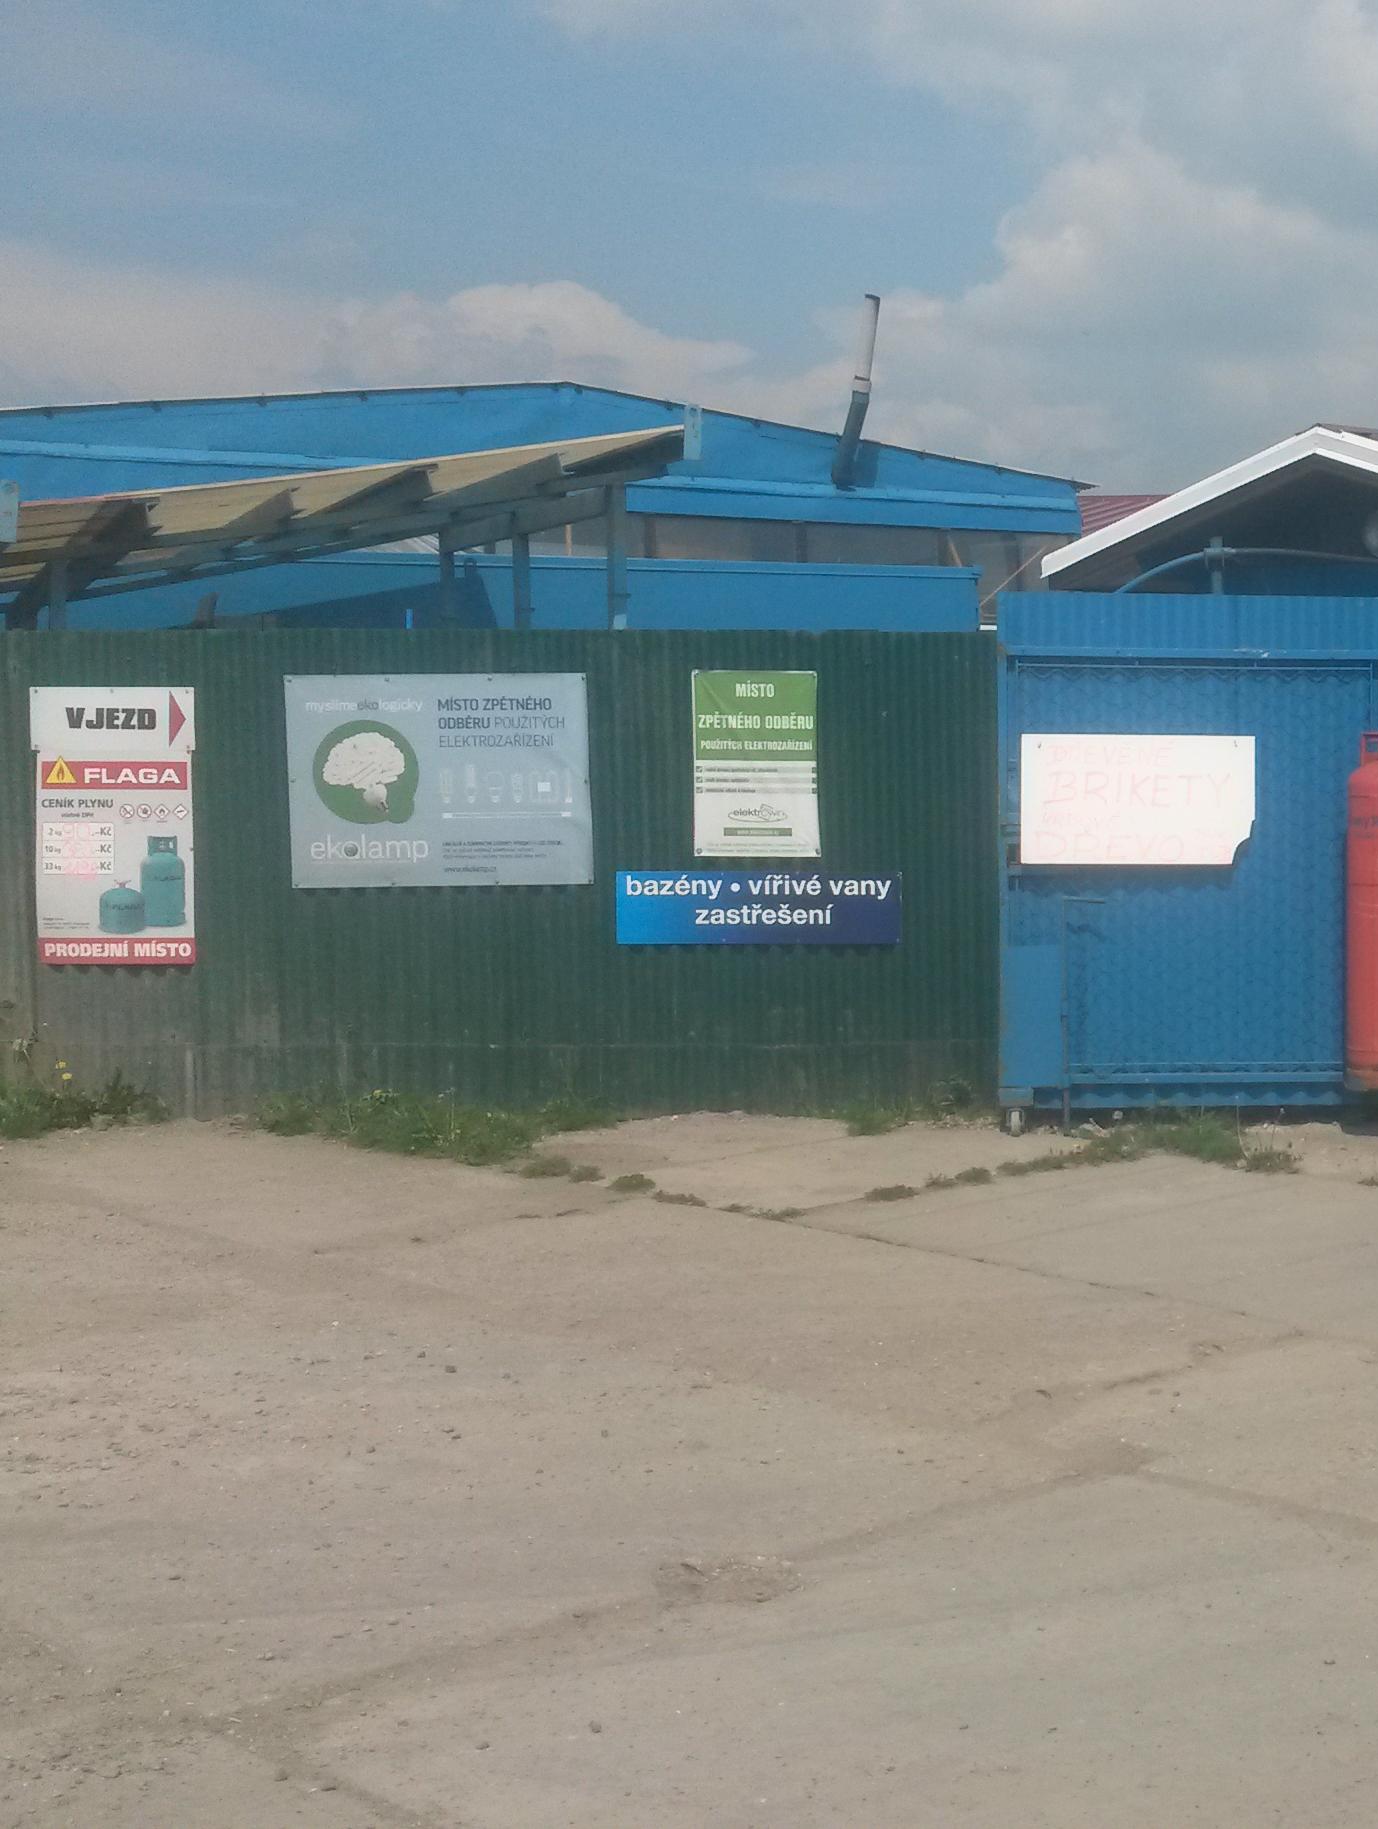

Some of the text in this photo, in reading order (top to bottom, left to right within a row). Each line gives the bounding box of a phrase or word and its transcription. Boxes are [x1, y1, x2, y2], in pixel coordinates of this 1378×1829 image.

[735, 680, 775, 698] MÍSTO
[437, 695, 552, 711] MÍSTO ZPĚTNÉHO
[65, 706, 157, 731] VJEZD
[438, 714, 491, 730] ODBĚRU
[698, 711, 814, 730] ZPĚTNÉHO ODBĚRU
[83, 768, 181, 784] FLAGA
[1043, 770, 1232, 808] BRIKETY
[41, 797, 114, 809] CENÍK PLYNU
[310, 834, 429, 864] ekolamp
[626, 874, 892, 900] bazény vířivé vany
[695, 903, 835, 925] zastřešení
[44, 940, 192, 959] PRODEJNÍ MÍSTO
